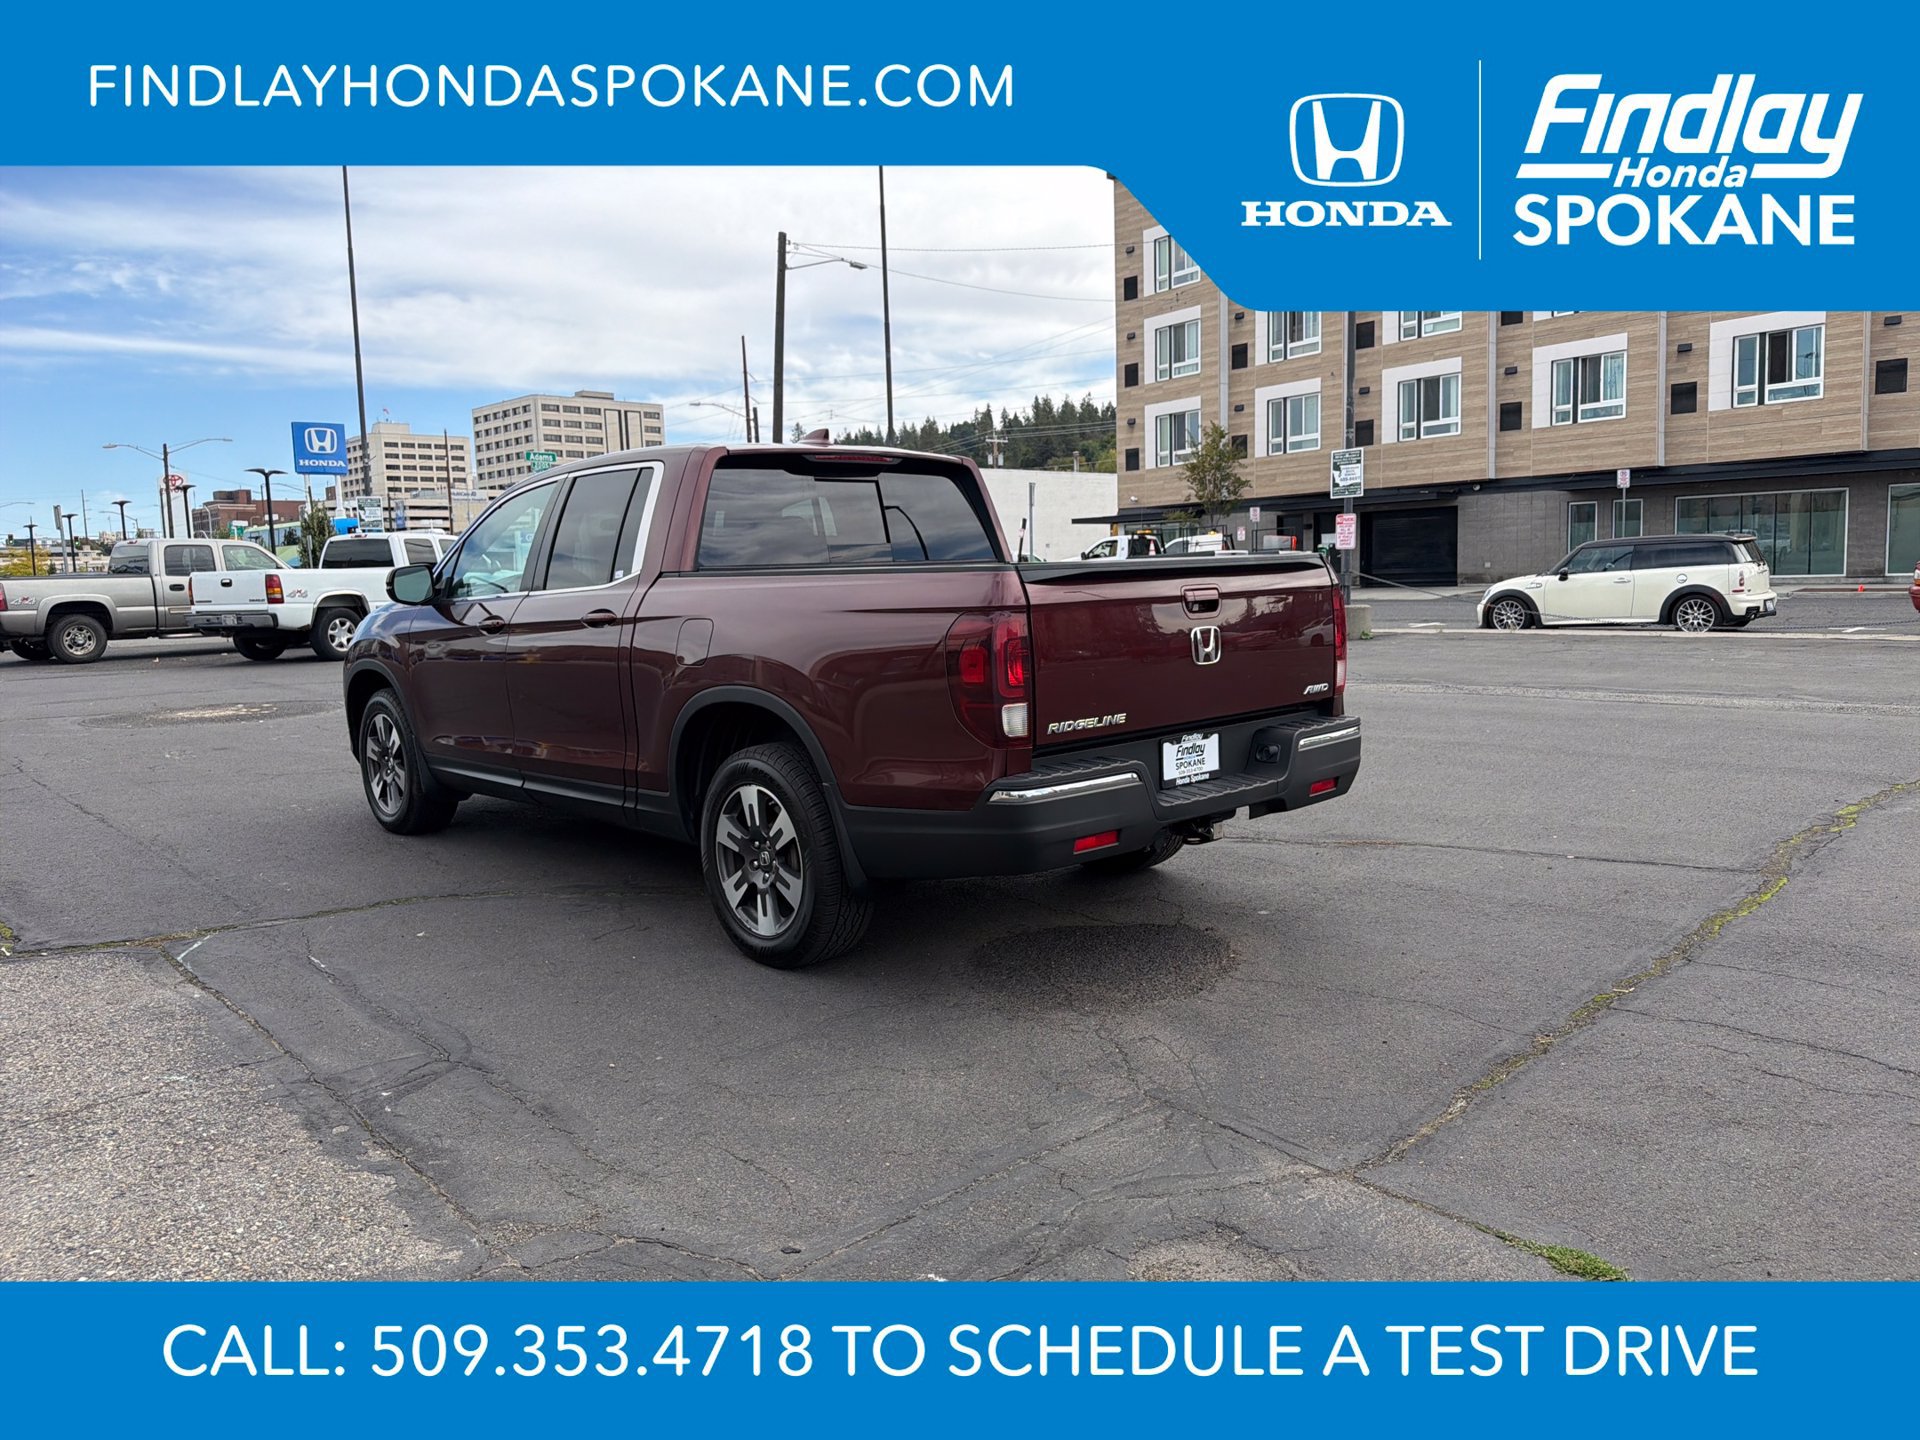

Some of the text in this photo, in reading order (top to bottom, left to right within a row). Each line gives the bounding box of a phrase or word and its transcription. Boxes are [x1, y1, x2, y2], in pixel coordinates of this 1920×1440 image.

[298, 459, 346, 467] HONDA
[529, 452, 554, 462] Adams
[1303, 683, 1329, 695] AWD
[1047, 713, 1127, 735] RIDGELINE
[1176, 743, 1205, 757] Findlay
[1176, 757, 1205, 770] SPOKANE
